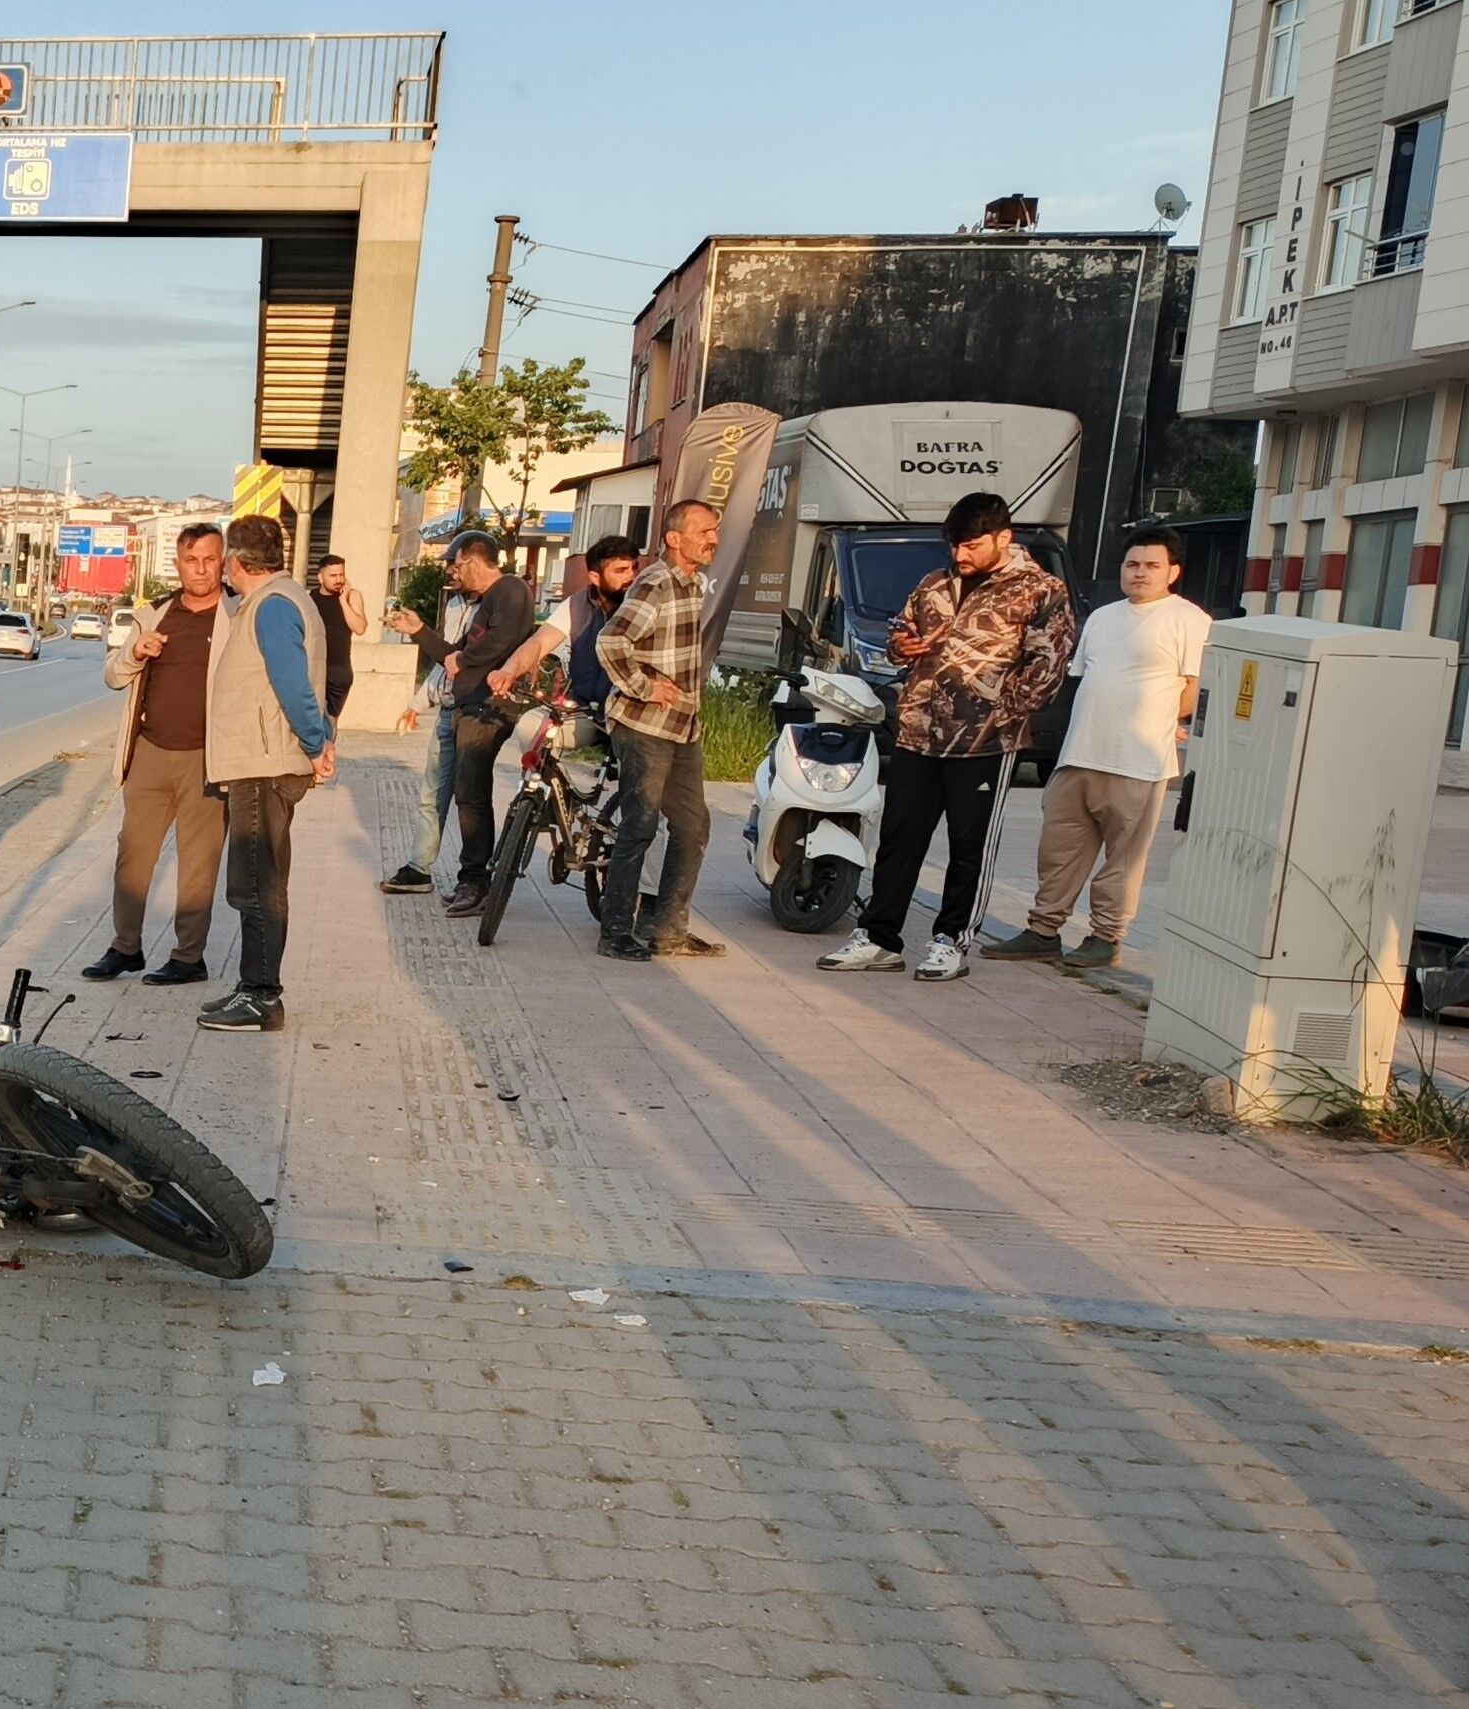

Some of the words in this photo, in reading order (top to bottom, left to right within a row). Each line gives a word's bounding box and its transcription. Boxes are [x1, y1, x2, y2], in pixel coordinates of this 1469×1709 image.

[10, 202, 39, 215] EDS
[916, 441, 984, 453] BAFRA
[900, 458, 1000, 477] DOĞTAŞ
